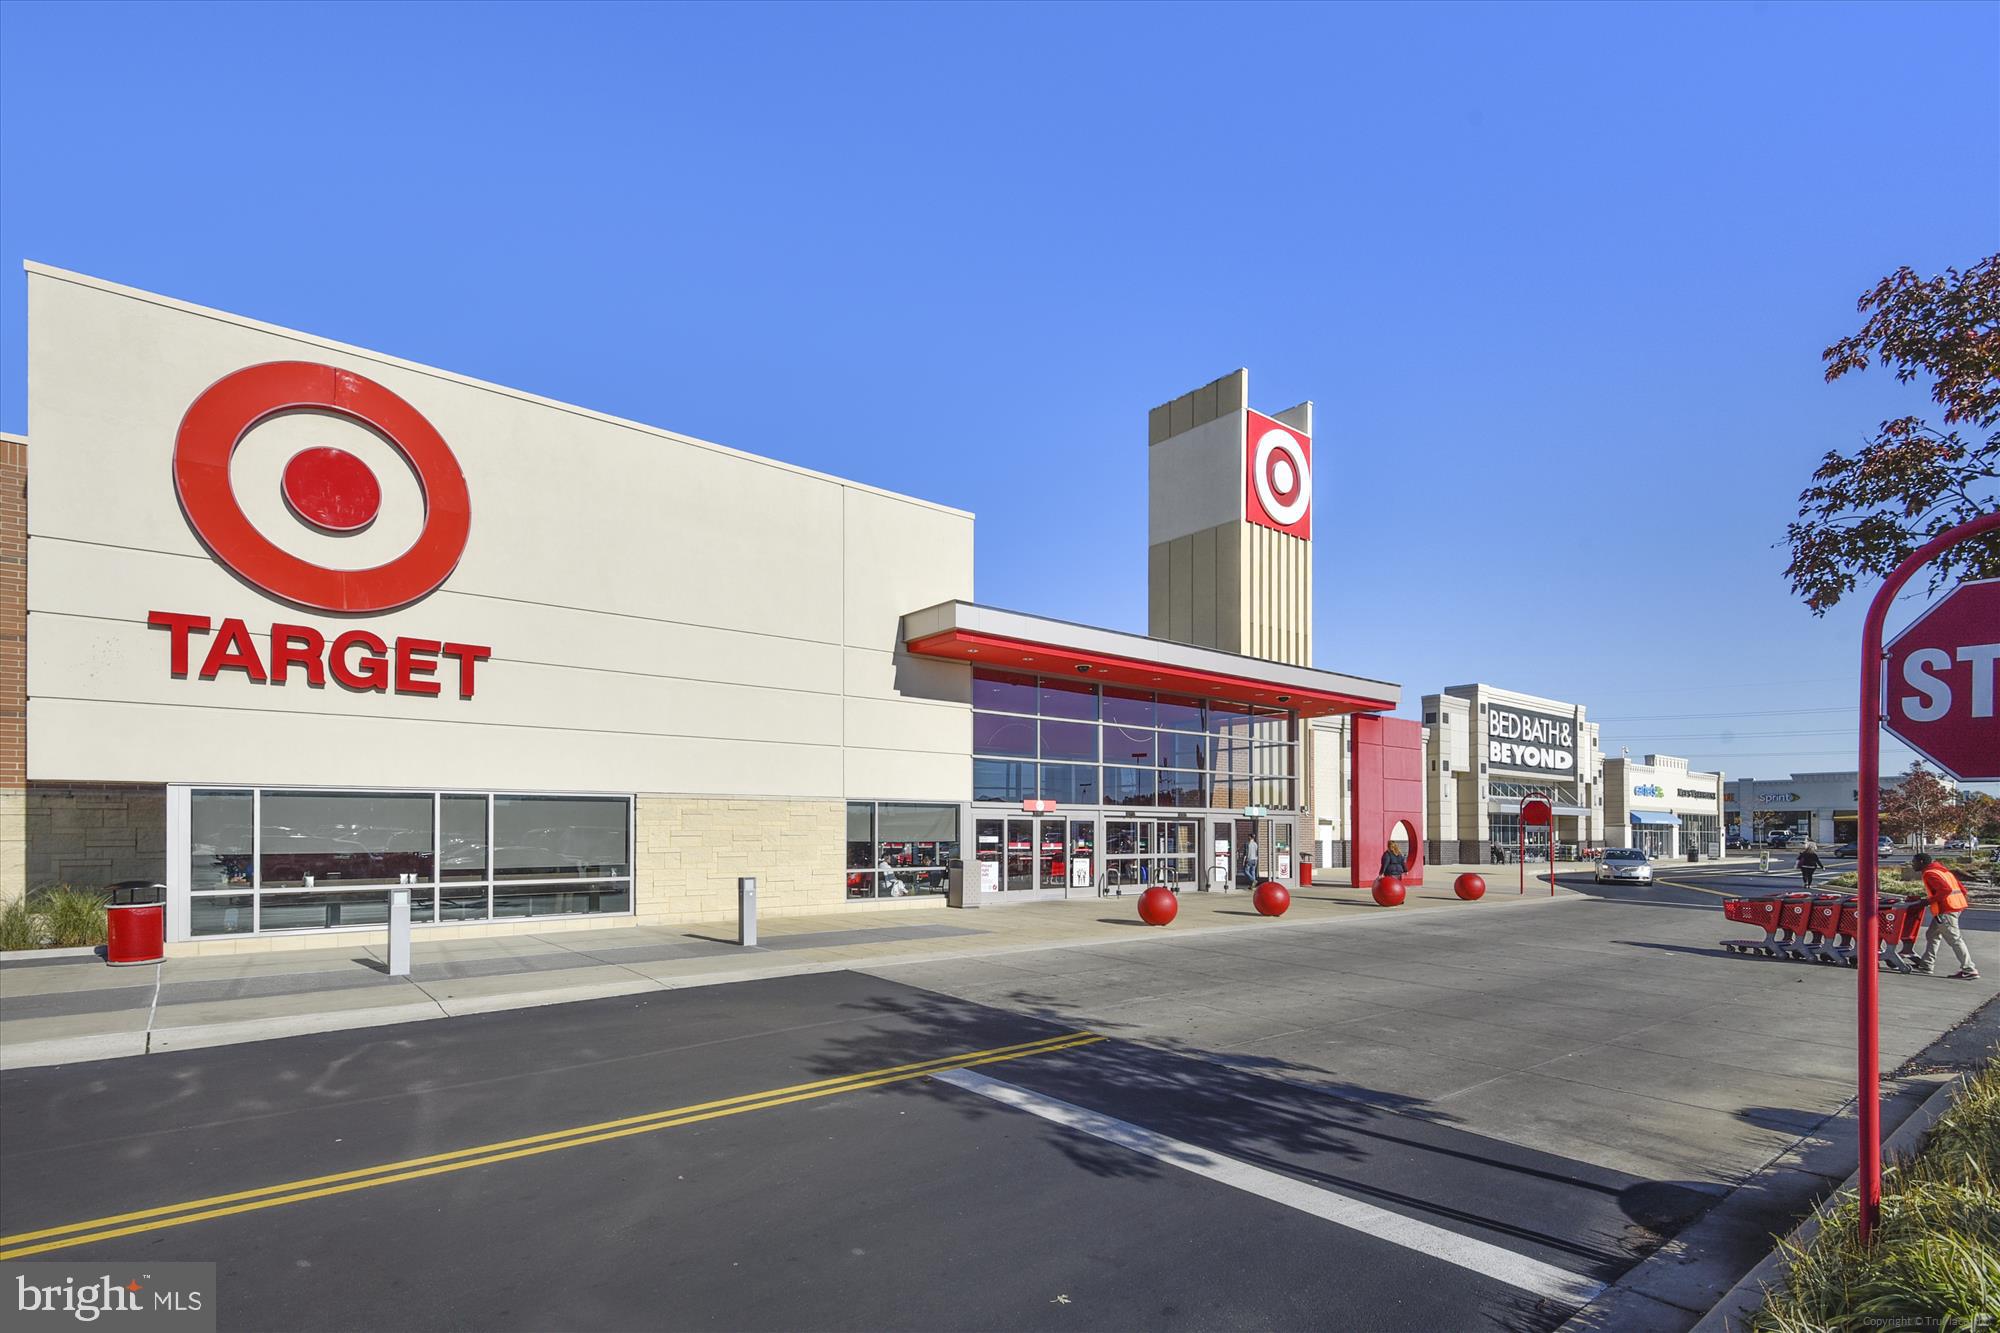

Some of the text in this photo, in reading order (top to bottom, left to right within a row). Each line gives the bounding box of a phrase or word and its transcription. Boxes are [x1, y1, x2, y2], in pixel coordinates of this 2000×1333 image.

[147, 610, 492, 699] TARGET
[1489, 709, 1573, 747] BED BATH &
[1489, 740, 1574, 770] BEYOND
[1759, 792, 1791, 804] Sprint
